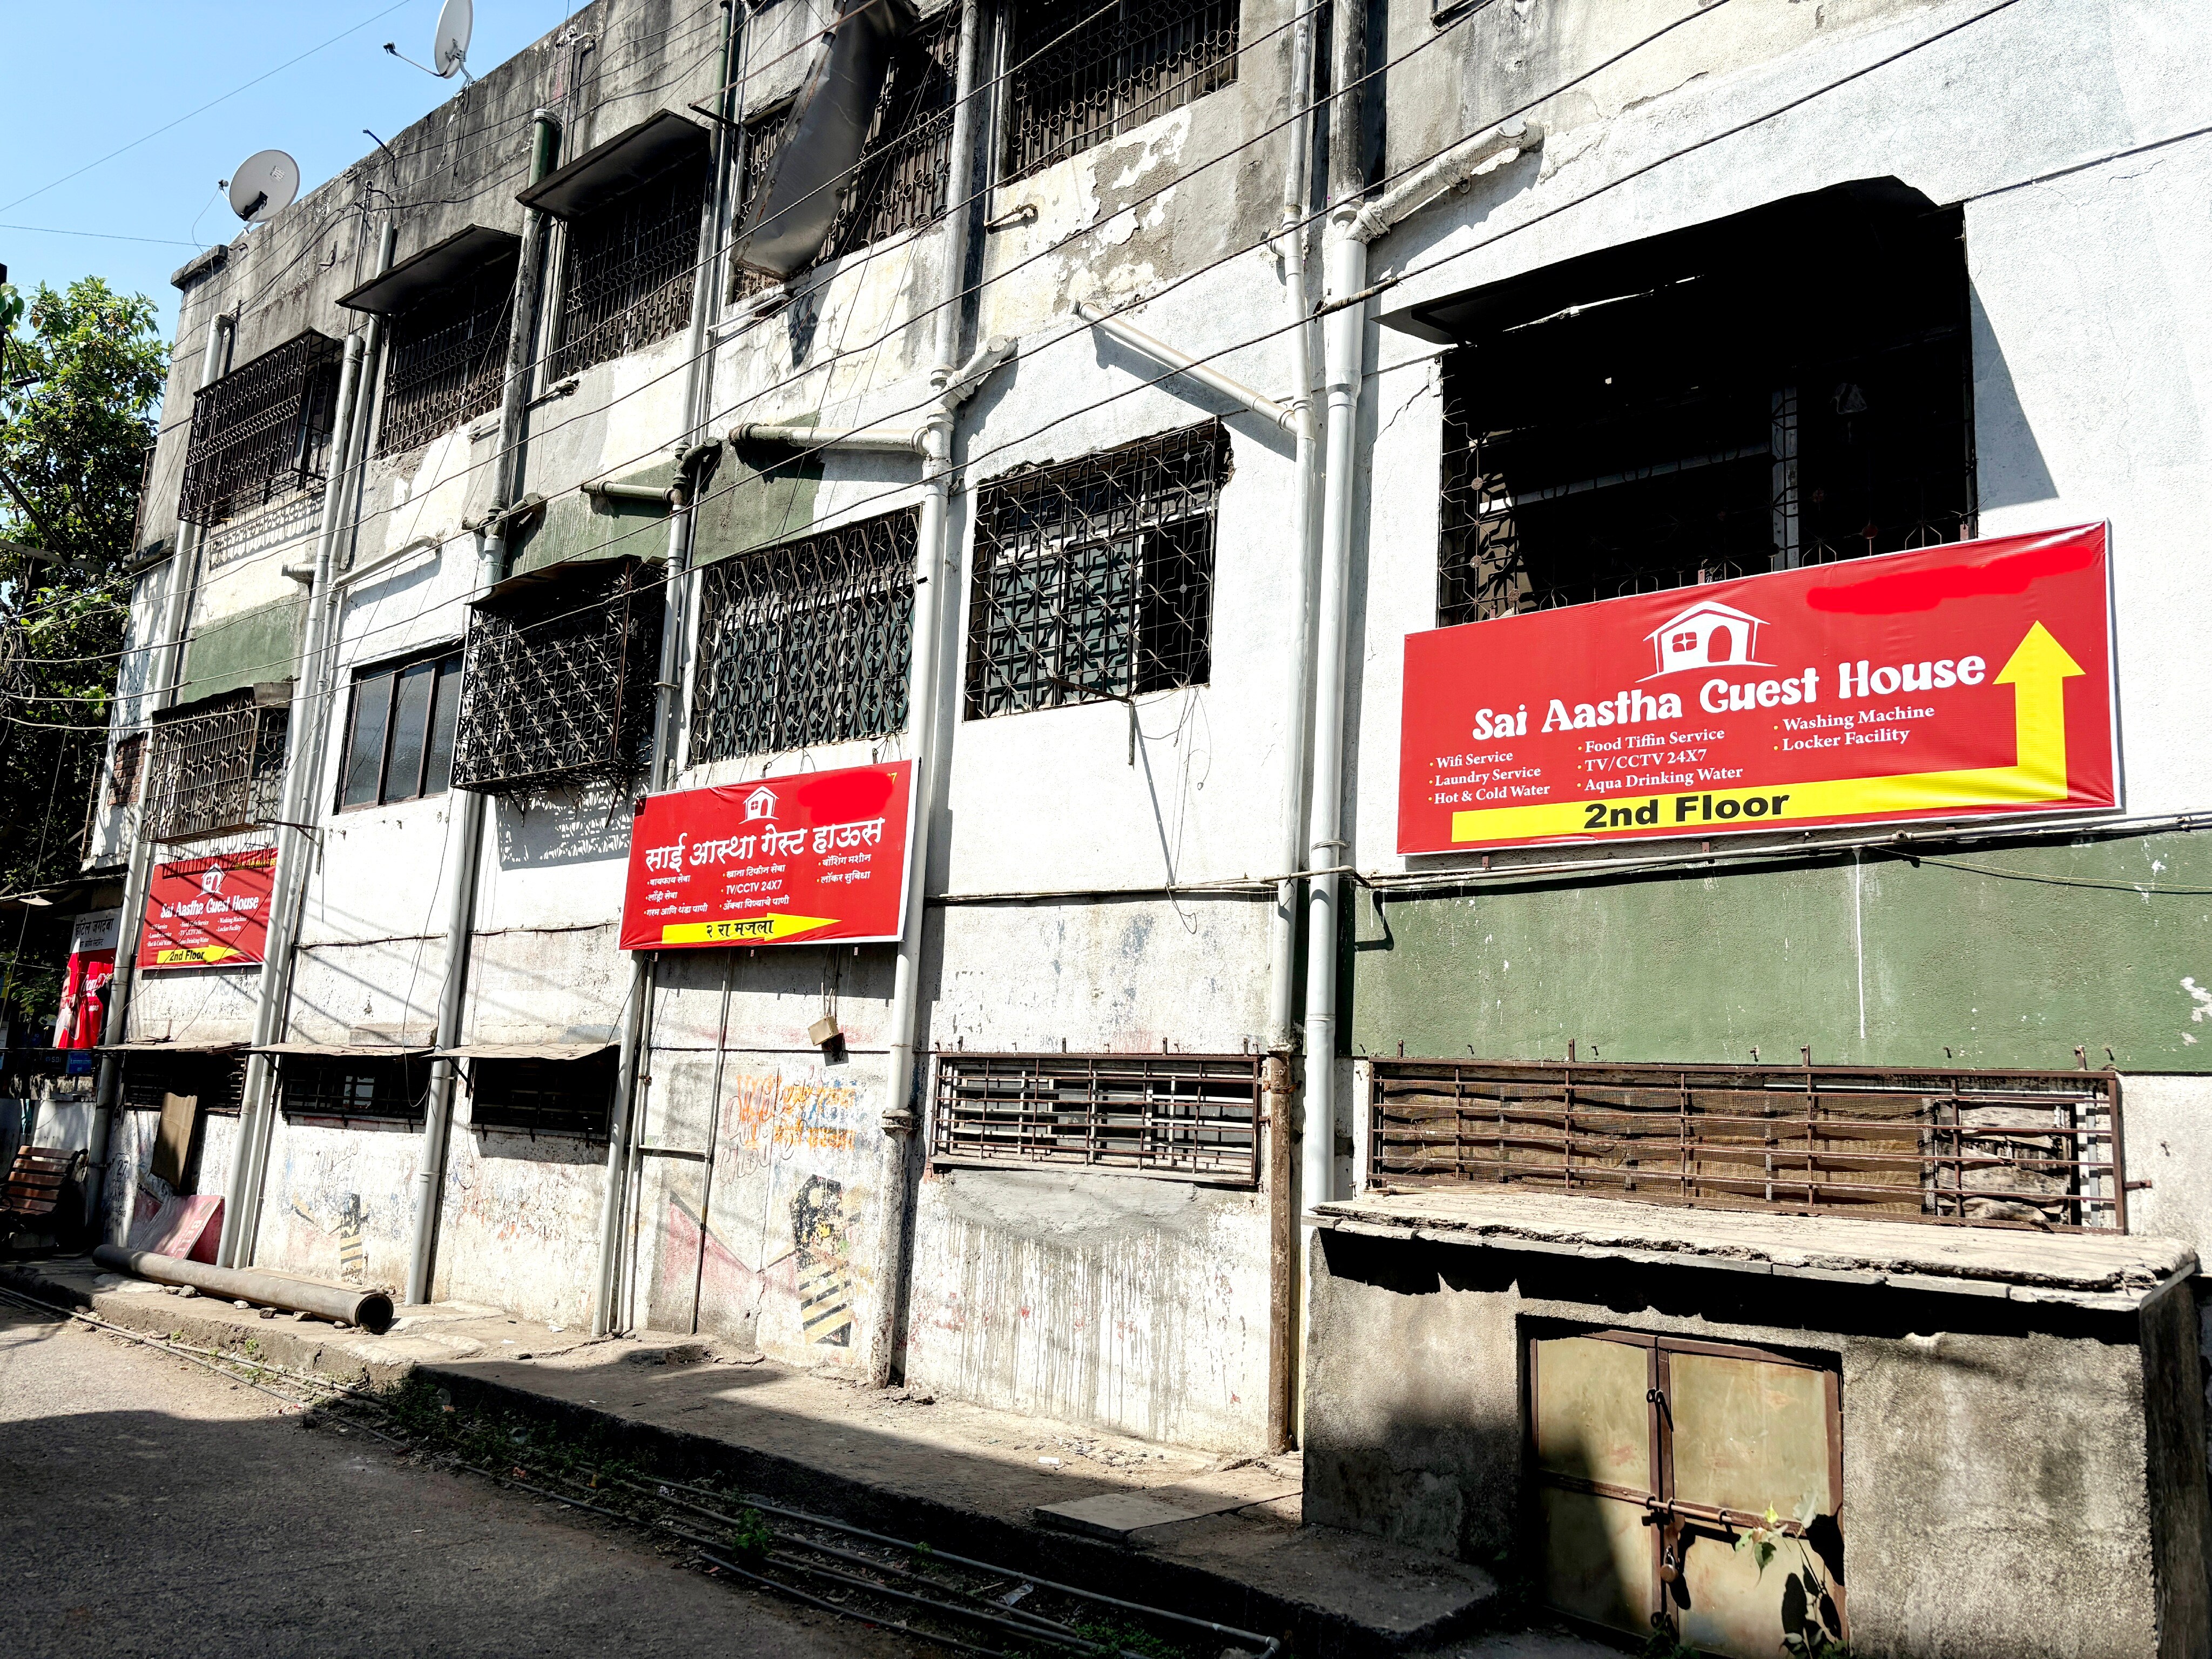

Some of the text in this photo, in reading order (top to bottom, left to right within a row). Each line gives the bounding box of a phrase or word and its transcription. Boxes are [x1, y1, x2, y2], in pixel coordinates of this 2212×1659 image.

[1472, 655, 1986, 740] Sai Aastha Guest House
[1783, 705, 1935, 731] Washing Machine
[1584, 729, 1725, 753] Food Tiffin Service
[1782, 728, 1911, 751] Locker Facility
[1435, 751, 1513, 768] Wifi Service
[1584, 748, 1707, 772] TV/CCTV 24X7
[1435, 767, 1541, 786] Laundry Service
[1584, 767, 1743, 794] Aqua Drinking Water
[1434, 785, 1550, 804] Hot & Cold Water
[1584, 793, 1790, 829] 2nd Floor
[645, 817, 886, 873] साई आस्था गेस्ट हाऊस
[822, 852, 872, 867] वॉशिंग मशीन
[726, 862, 786, 878] खाना टिफीन सेवा
[820, 869, 871, 884] लॉकर सुविधा
[650, 873, 691, 886] वायफाय सेवा
[726, 879, 783, 895] TV/CCTV 24X7
[664, 890, 678, 900] सेवा
[772, 894, 790, 905] पाणी
[160, 895, 259, 918] Sai Aastha Guest House
[646, 902, 709, 916] गरम आणि थंडा पाणी
[706, 920, 774, 938] २ रा मजला
[170, 950, 205, 961] 2nd Floor
